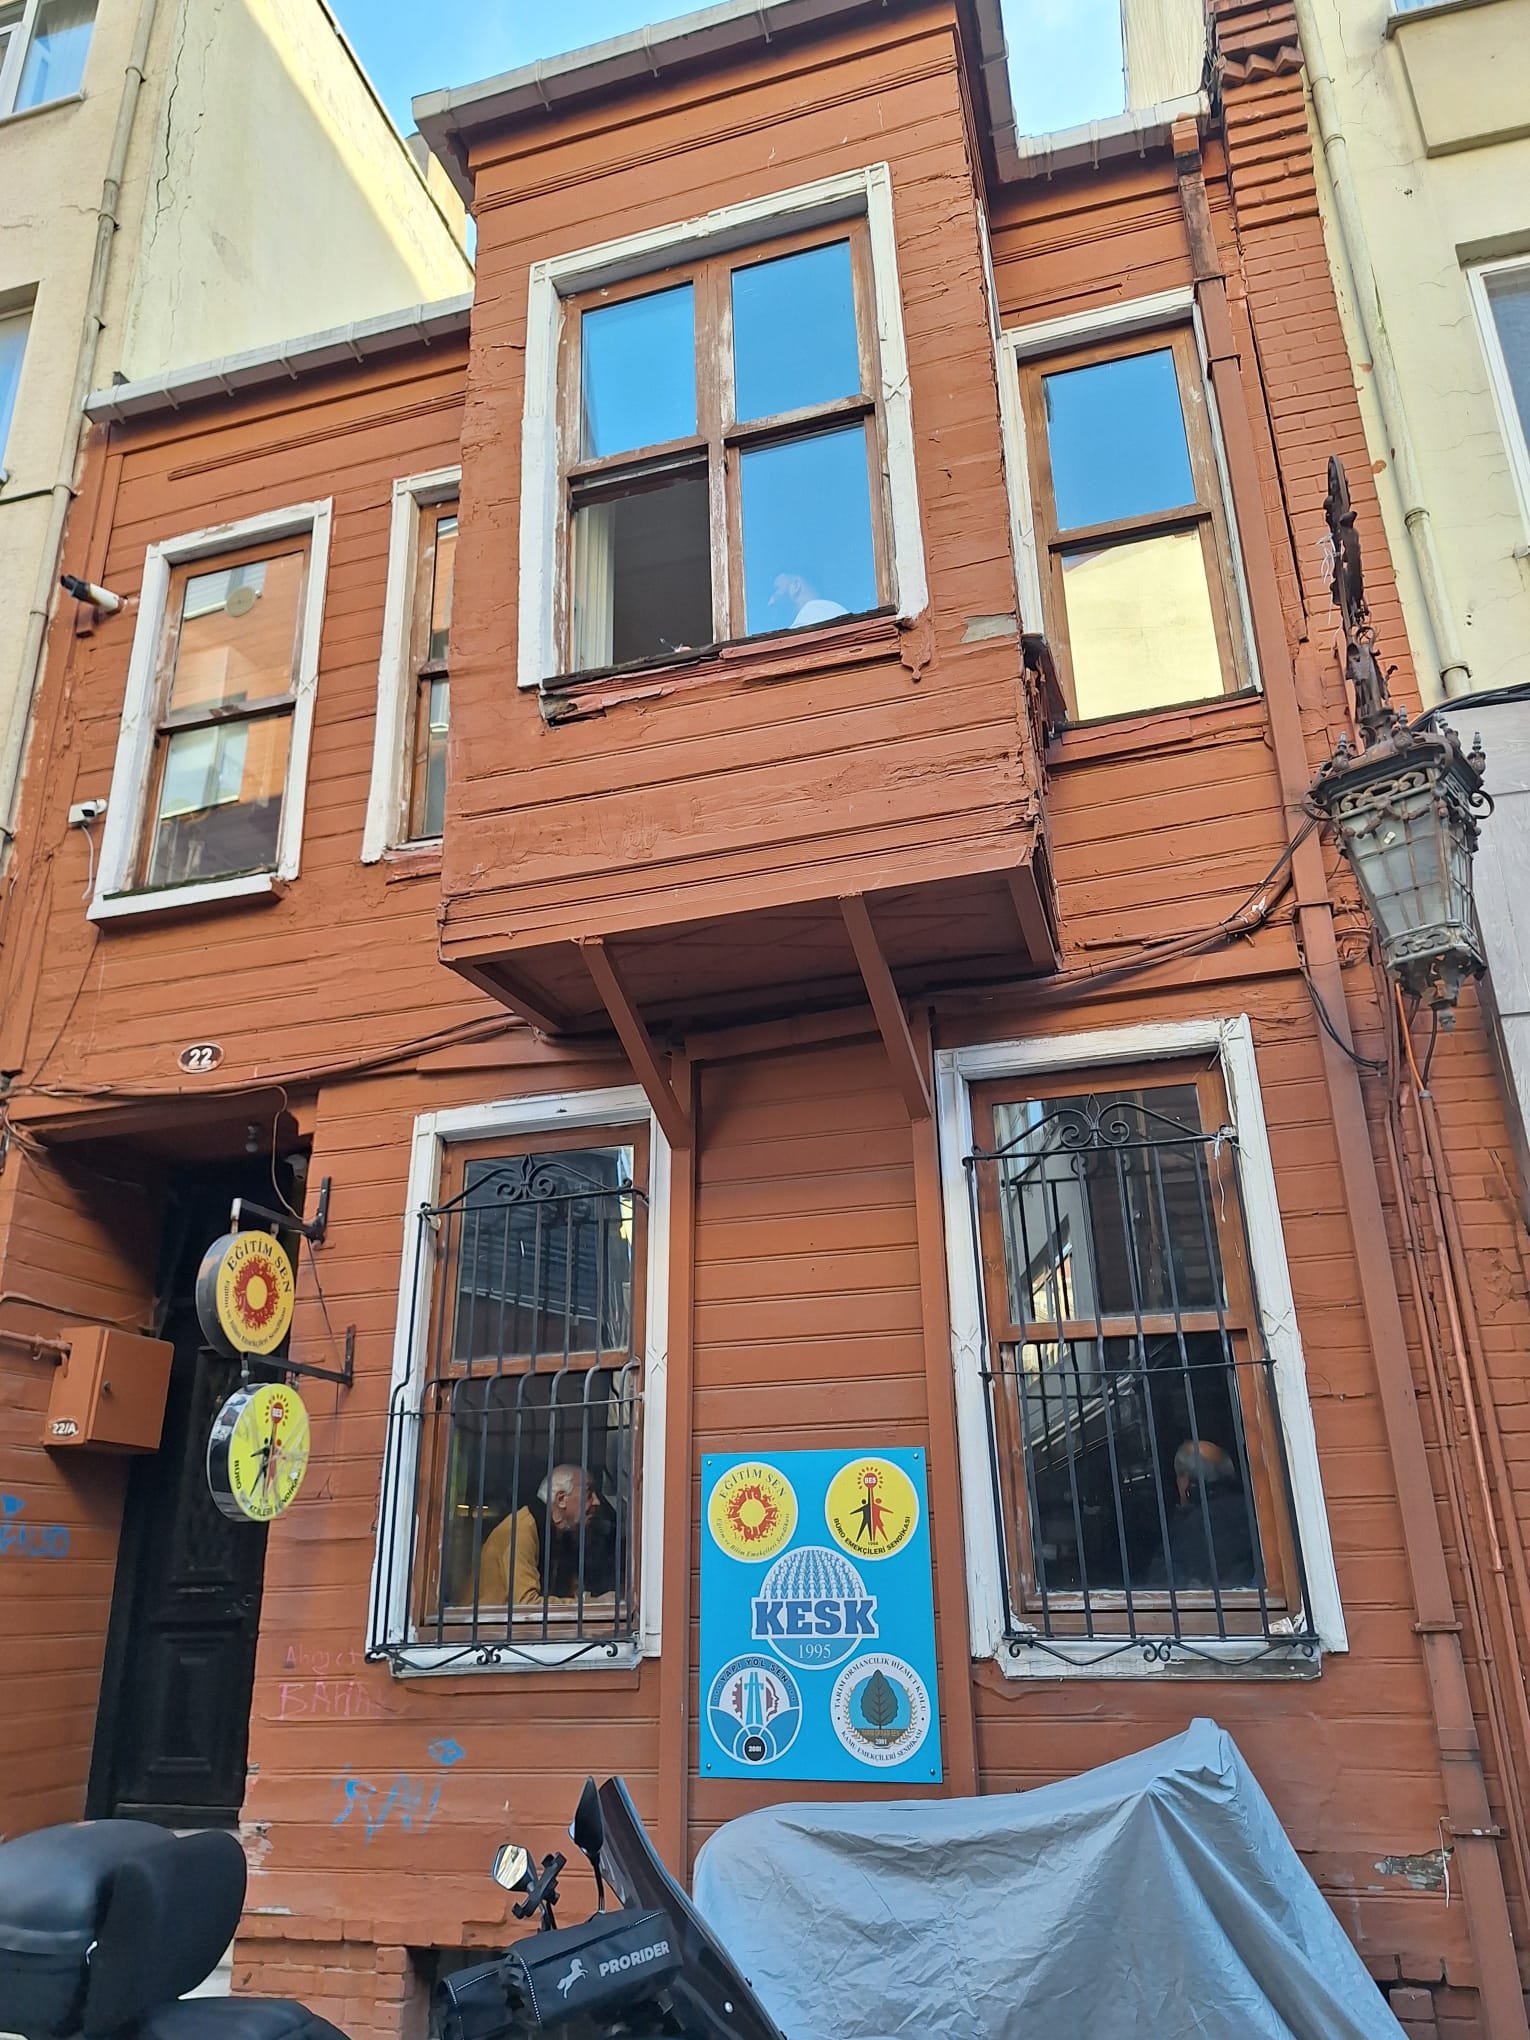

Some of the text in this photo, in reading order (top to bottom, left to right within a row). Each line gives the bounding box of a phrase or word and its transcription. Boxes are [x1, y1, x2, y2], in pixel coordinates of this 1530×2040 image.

[188, 1047, 213, 1067] 22
[227, 1238, 292, 1293] EĞİTİM SEN
[52, 1422, 76, 1435] 22/A
[766, 1474, 785, 1497] SEN
[845, 1537, 886, 1556] EMEKÇİLERİ
[887, 1516, 911, 1551] SENDİKASI
[754, 1599, 876, 1636] KESK
[799, 1643, 831, 1659] 1995
[720, 1658, 789, 1683] YAPI YOL SEN
[834, 1679, 847, 1709] TARIM
[844, 1657, 890, 1681] ORMANCILIK
[915, 1685, 927, 1712] KOLU
[841, 1730, 860, 1750] KAMU
[598, 1940, 671, 1977] PRORIDER
